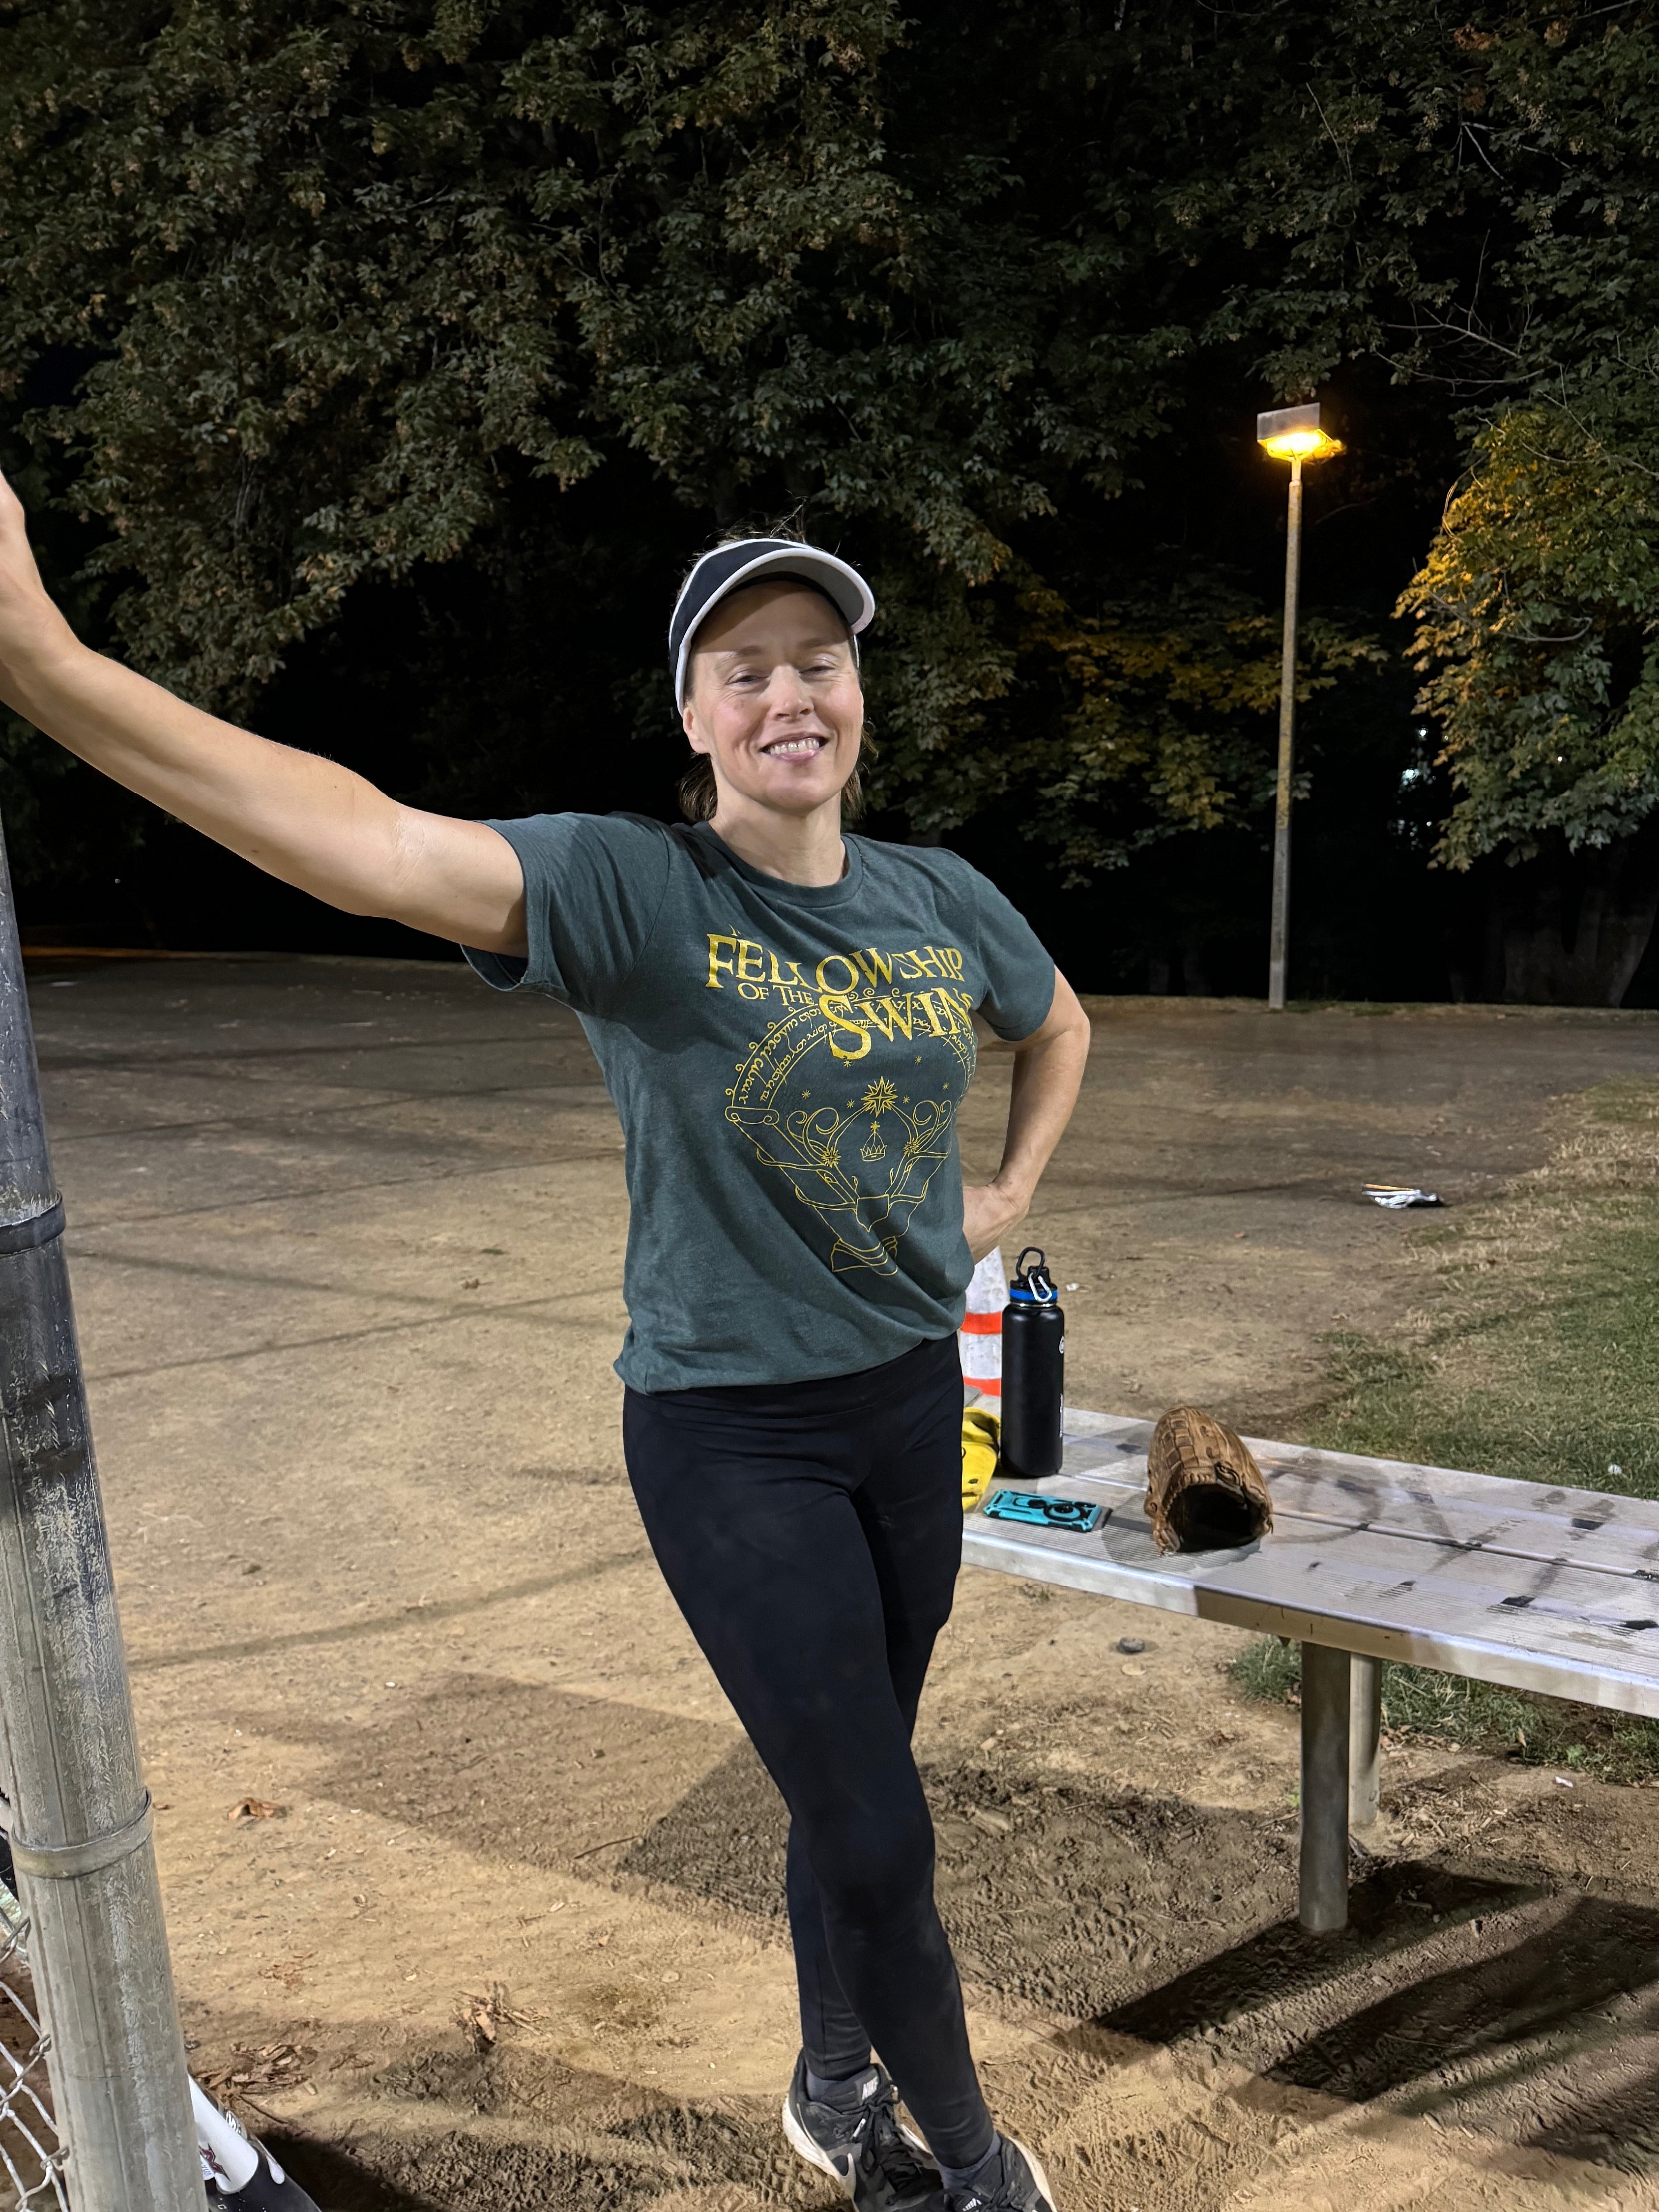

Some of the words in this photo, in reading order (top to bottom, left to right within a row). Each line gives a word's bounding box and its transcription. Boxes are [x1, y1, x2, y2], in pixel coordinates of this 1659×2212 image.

[705, 933, 964, 995] FELLOWSHIP
[738, 983, 769, 1000] OF
[773, 985, 815, 1006] THE
[818, 987, 974, 1060] SWIN
